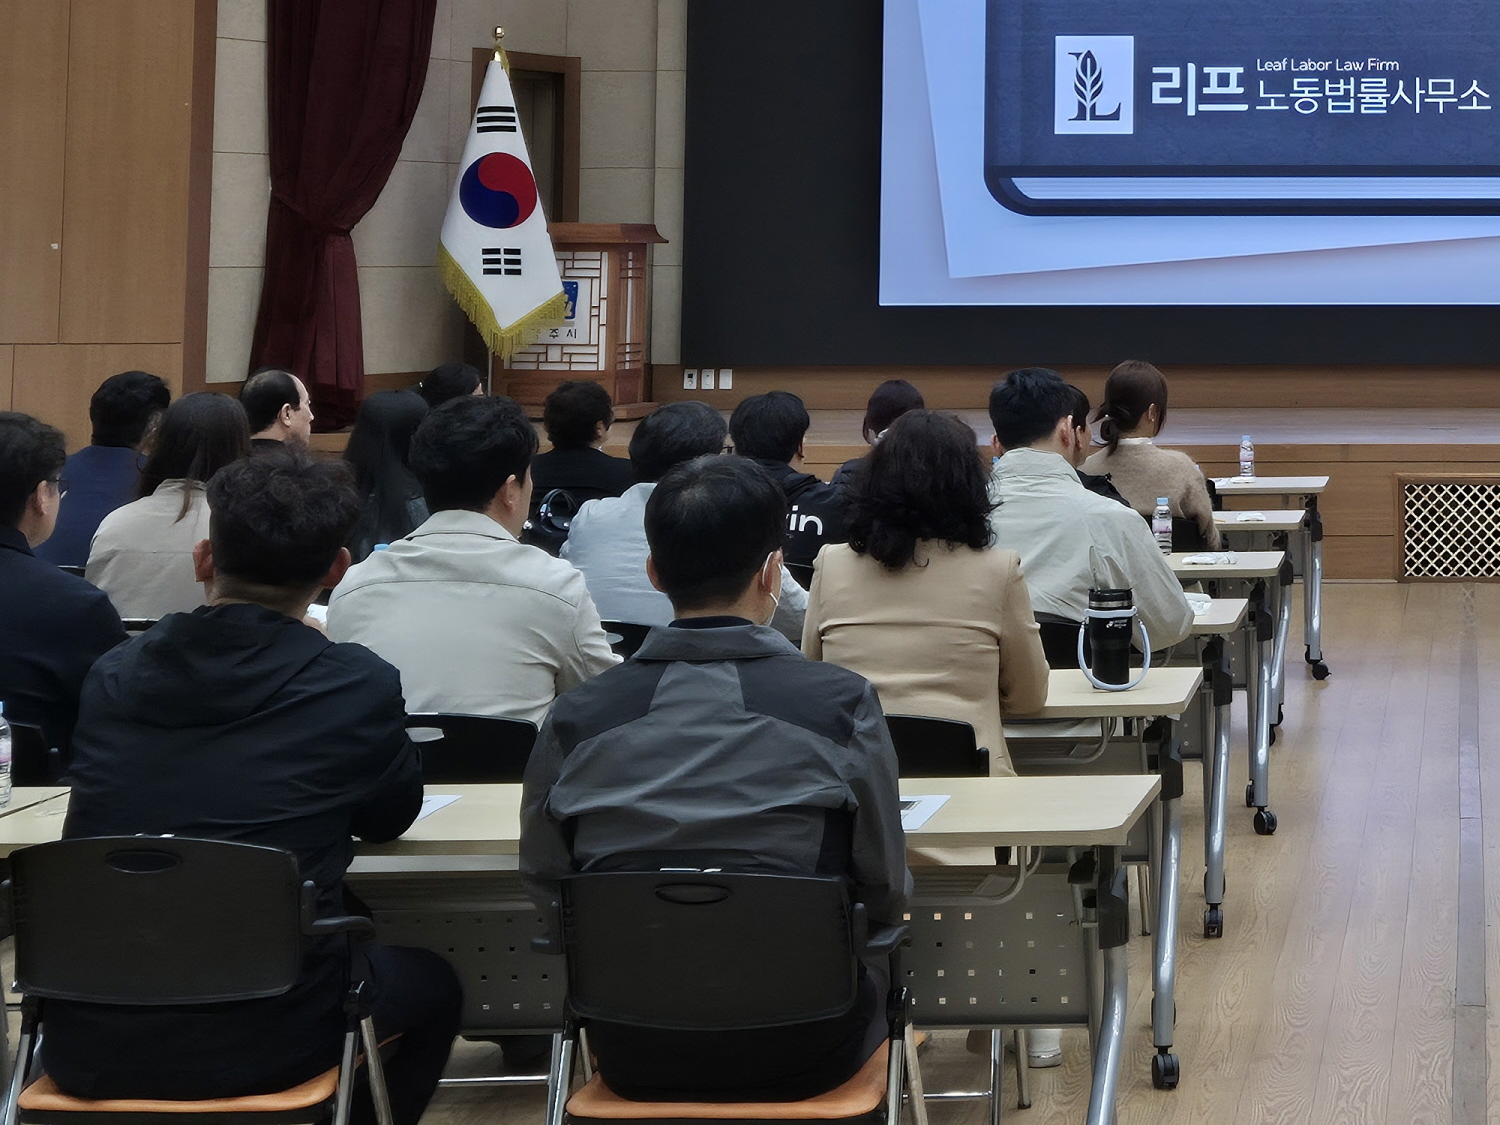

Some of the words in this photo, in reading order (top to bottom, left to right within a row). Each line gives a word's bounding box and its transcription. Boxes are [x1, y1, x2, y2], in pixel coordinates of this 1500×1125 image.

[1256, 57, 1288, 72] Leaf
[1290, 57, 1333, 72] Labor
[1335, 57, 1365, 72] Law
[1367, 57, 1400, 72] Firm
[1151, 62, 1249, 117] 리프
[1255, 76, 1492, 115] 노동법률사무소
